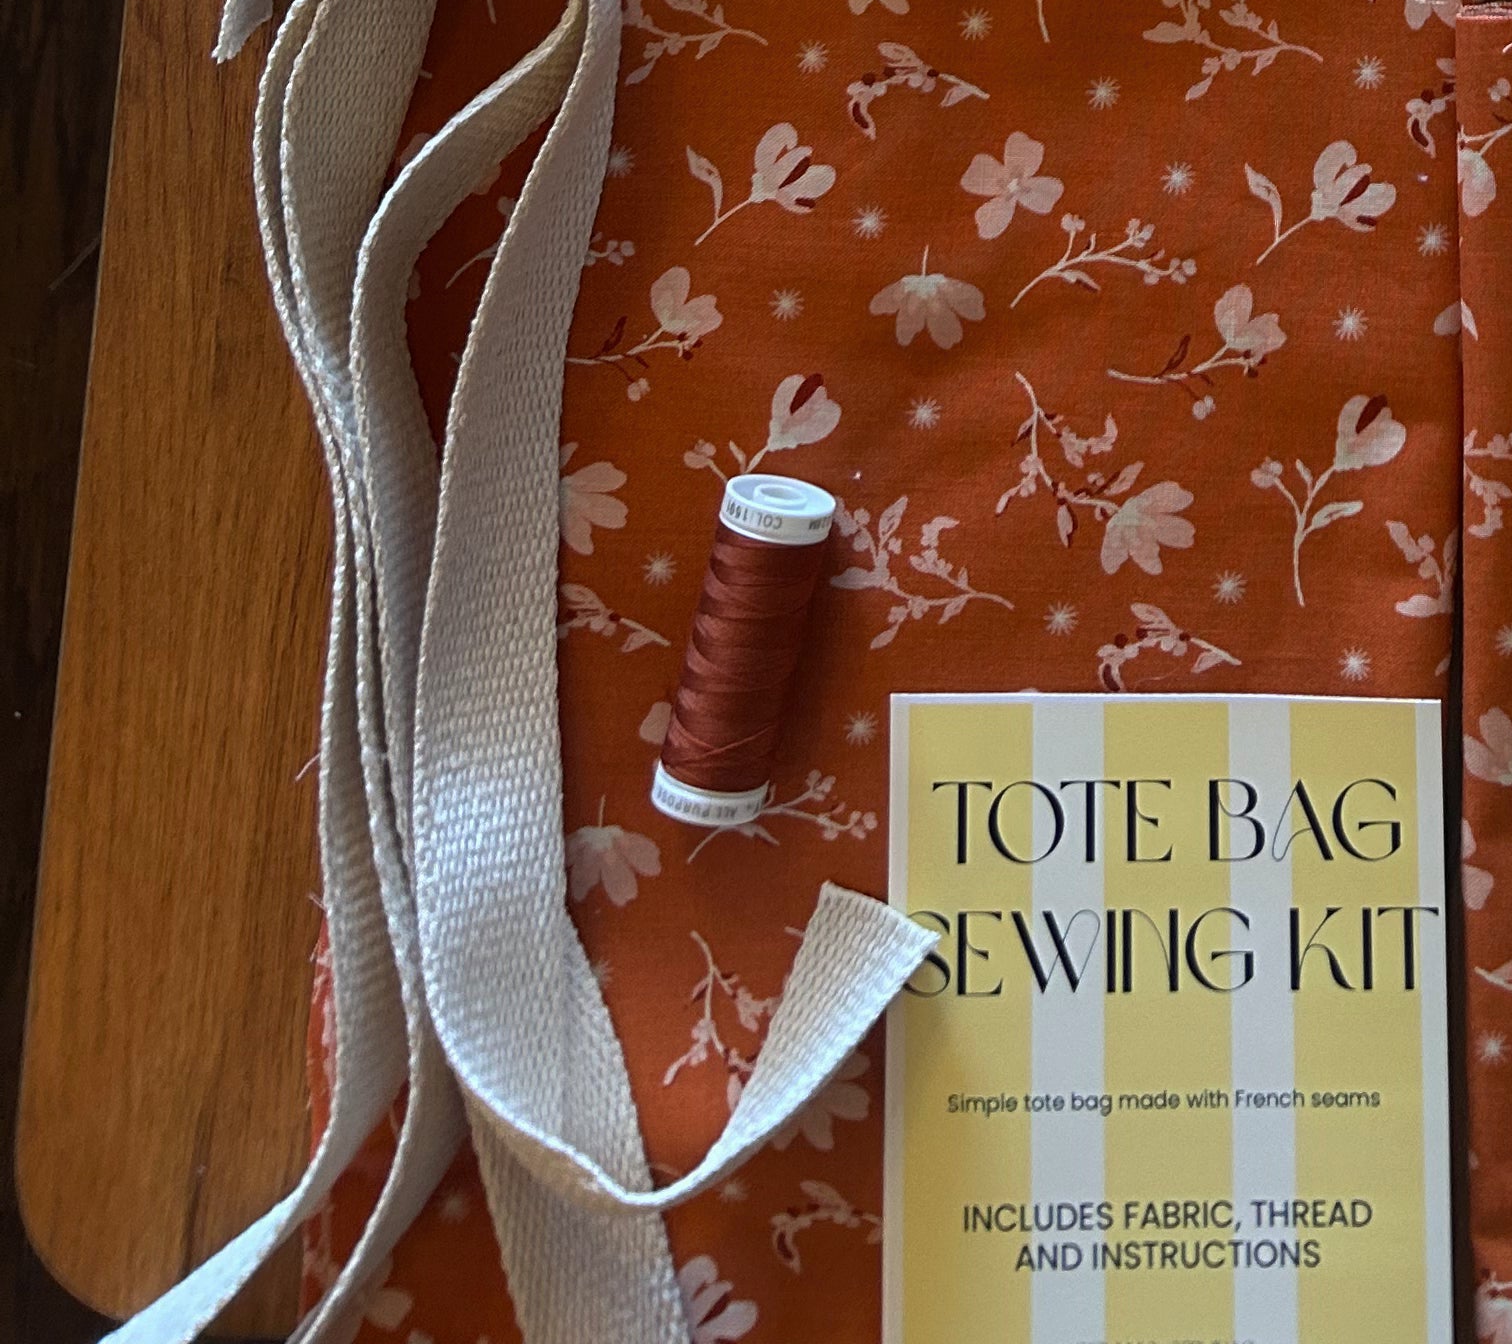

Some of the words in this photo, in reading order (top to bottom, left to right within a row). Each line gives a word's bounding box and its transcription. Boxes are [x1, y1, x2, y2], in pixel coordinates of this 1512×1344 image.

[932, 779, 1173, 865] TOTE
[1208, 778, 1402, 862] BAG
[901, 907, 1255, 997] SEWING
[1289, 906, 1440, 992] KIT
[947, 1092, 1019, 1118] Simple
[1022, 1093, 1066, 1113] tote
[1070, 1092, 1114, 1118] bag
[1117, 1089, 1181, 1111] made
[1185, 1088, 1230, 1110] with
[1234, 1088, 1306, 1109] French
[1310, 1091, 1381, 1109] seams
[963, 1200, 1115, 1233] INCLUDES
[1123, 1199, 1242, 1234] FABRIC,
[1249, 1198, 1373, 1229] THREAD
[1014, 1241, 1084, 1272] AND
[1092, 1238, 1321, 1271] INSTRUCTIONS
